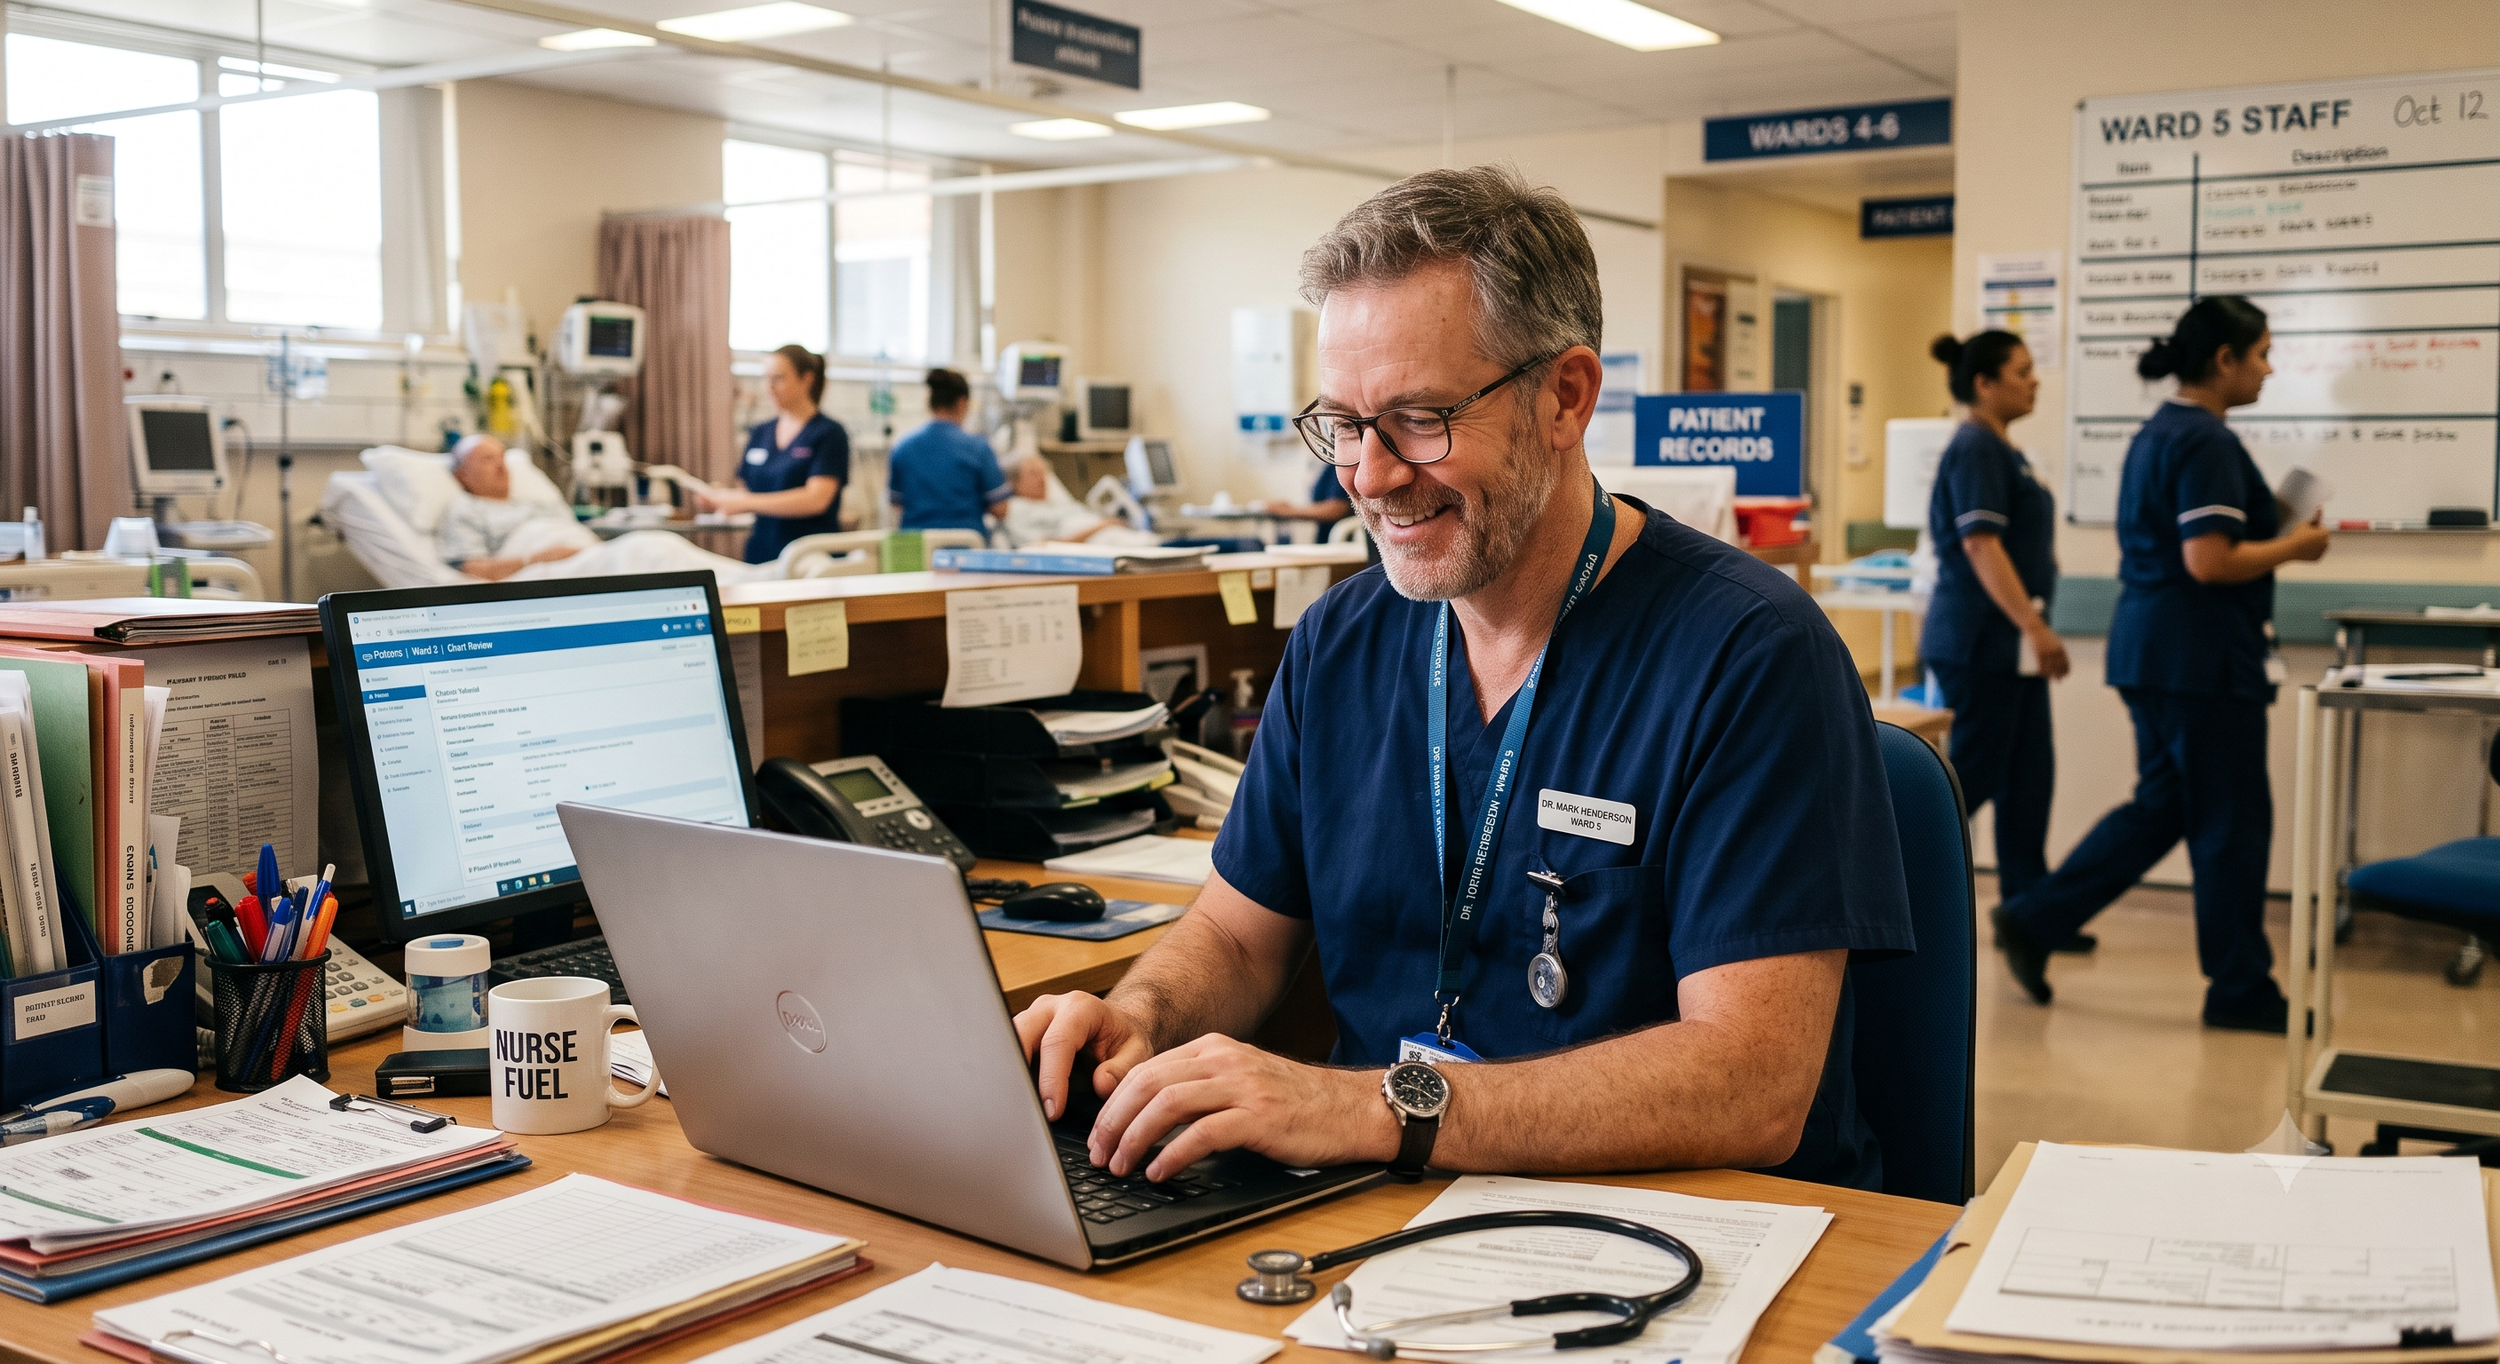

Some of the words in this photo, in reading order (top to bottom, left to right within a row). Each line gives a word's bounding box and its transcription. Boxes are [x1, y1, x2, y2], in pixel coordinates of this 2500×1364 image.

[2100, 111, 2202, 144] WARD
[2211, 108, 2232, 137] 5
[2241, 98, 2353, 136] STAFF
[2392, 94, 2443, 128] Oct
[2458, 90, 2490, 121] 12
[1749, 115, 1850, 151] WARDS
[1852, 111, 1900, 142] 4-6
[1668, 406, 1766, 433] PATIENT
[1658, 435, 1774, 463] RECORDS
[411, 645, 432, 656] Ward
[447, 642, 467, 653] Chart
[467, 641, 493, 651] Review
[1541, 799, 1555, 810] DR.
[1556, 802, 1580, 814] MARK
[1580, 807, 1632, 825] HENDERSON
[1570, 817, 1595, 830] WARD
[496, 1028, 578, 1064] NURSE
[505, 1066, 569, 1100] FUEL
